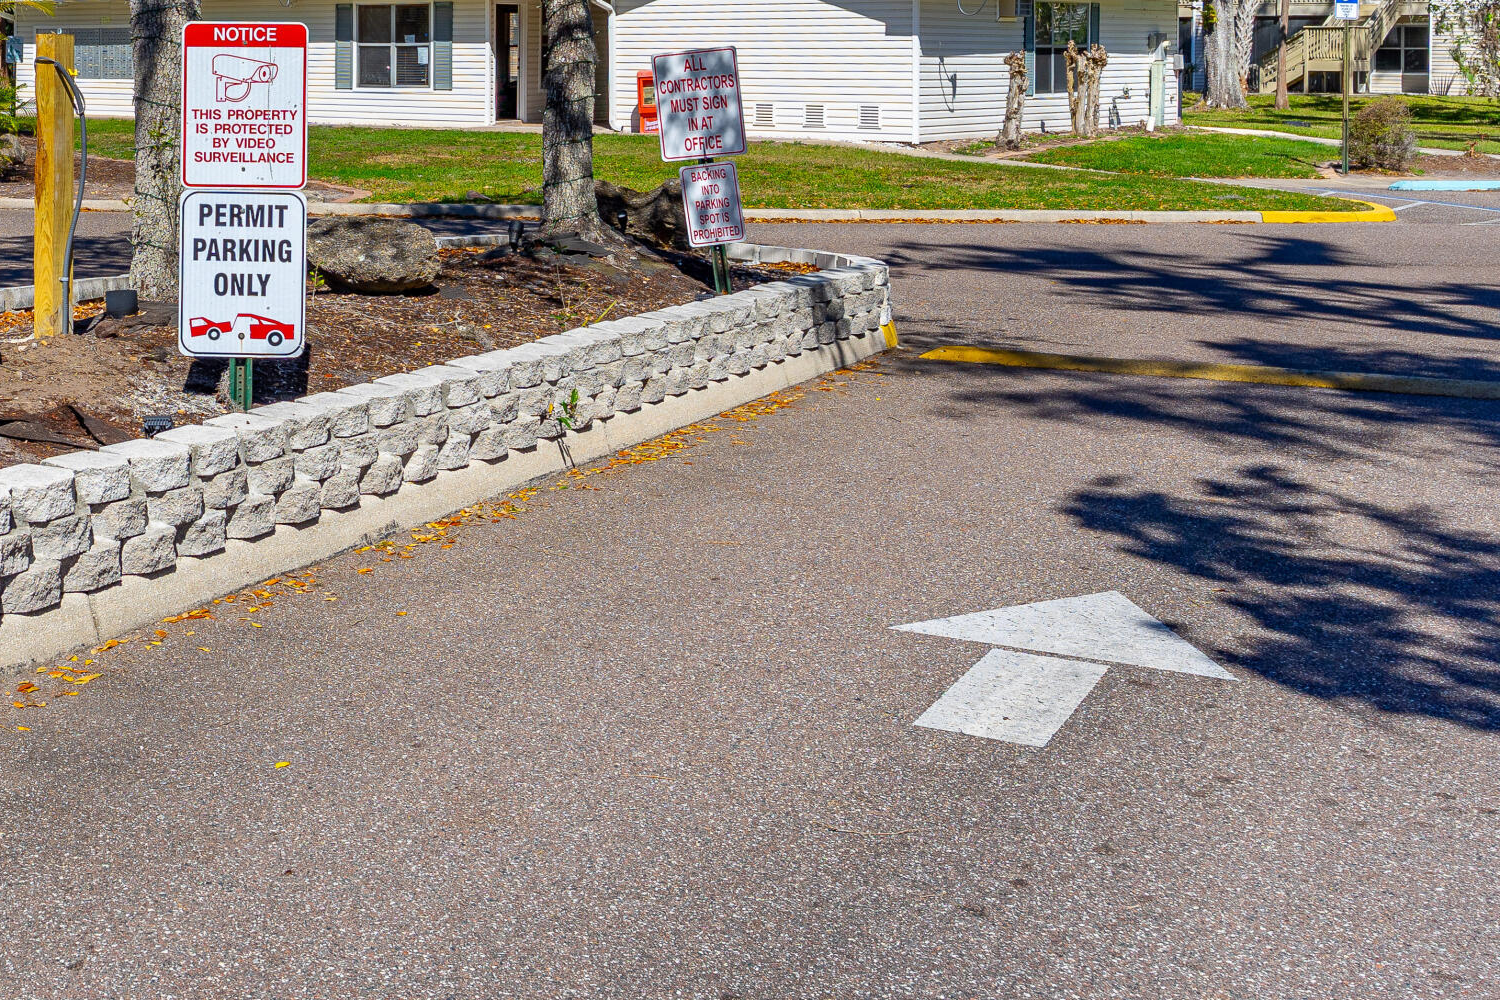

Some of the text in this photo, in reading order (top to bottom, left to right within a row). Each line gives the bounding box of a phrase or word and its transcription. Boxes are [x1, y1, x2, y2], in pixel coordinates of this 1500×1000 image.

[213, 26, 277, 42] NOTICE
[683, 57, 707, 73] ALL
[659, 74, 735, 94] CONTRACTORS
[670, 95, 728, 113] MUST SIGN
[191, 109, 298, 121] THIS PROPERTY
[195, 123, 294, 135] IS PROTECTED
[688, 116, 714, 131] IN AT
[212, 137, 276, 149] BY VIDEO
[684, 135, 723, 152] OFFICE
[194, 151, 295, 164] SURVEILLANCE
[691, 168, 727, 183] BACKING
[701, 183, 720, 196] INTO
[695, 197, 730, 212] PARKING
[198, 203, 289, 229] PERMIT
[699, 211, 730, 226] SPOT IS
[693, 224, 741, 241] PROHIBITED
[192, 238, 293, 263] PARKING
[213, 272, 272, 298] ONLY
